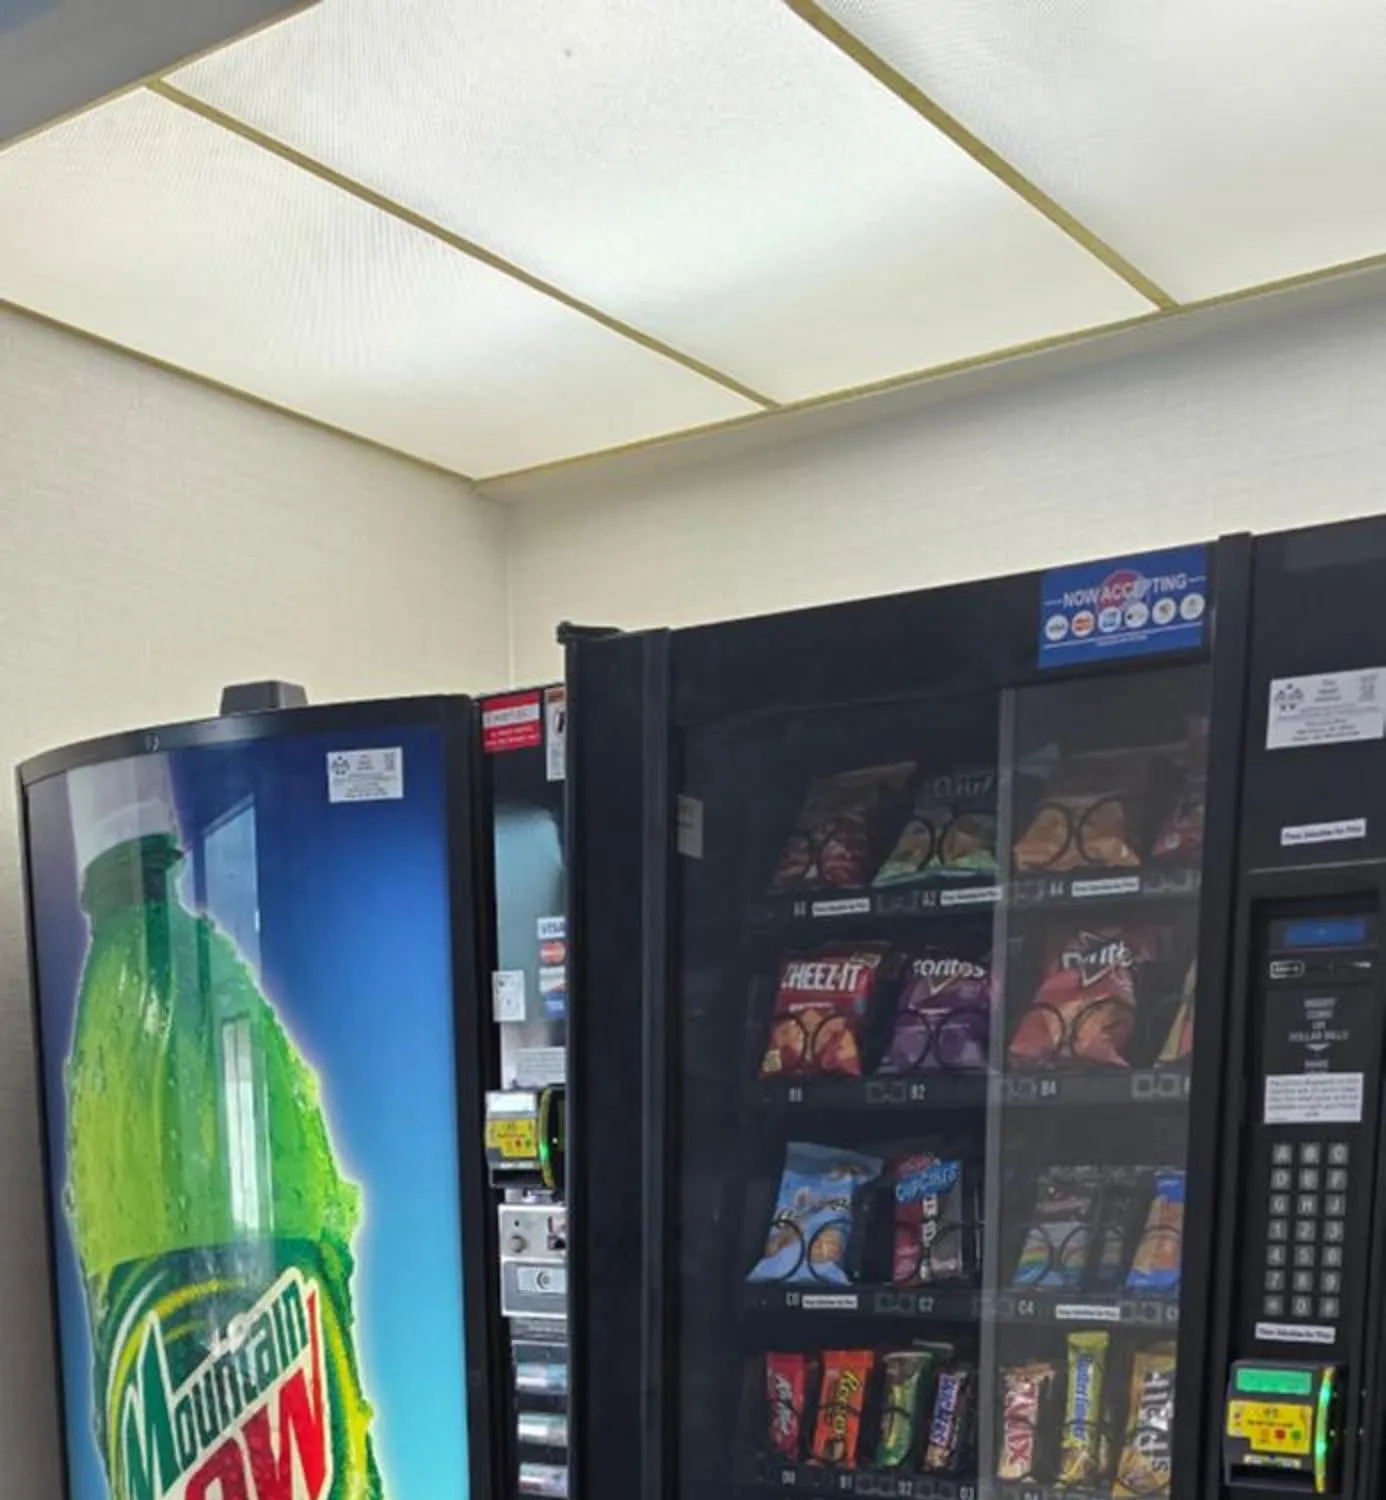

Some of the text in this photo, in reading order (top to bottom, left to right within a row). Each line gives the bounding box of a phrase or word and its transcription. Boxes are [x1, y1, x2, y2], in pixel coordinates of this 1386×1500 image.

[1063, 586, 1099, 608] NOW
[1040, 1079, 1057, 1097] B4
[1017, 1299, 1034, 1316] C4
